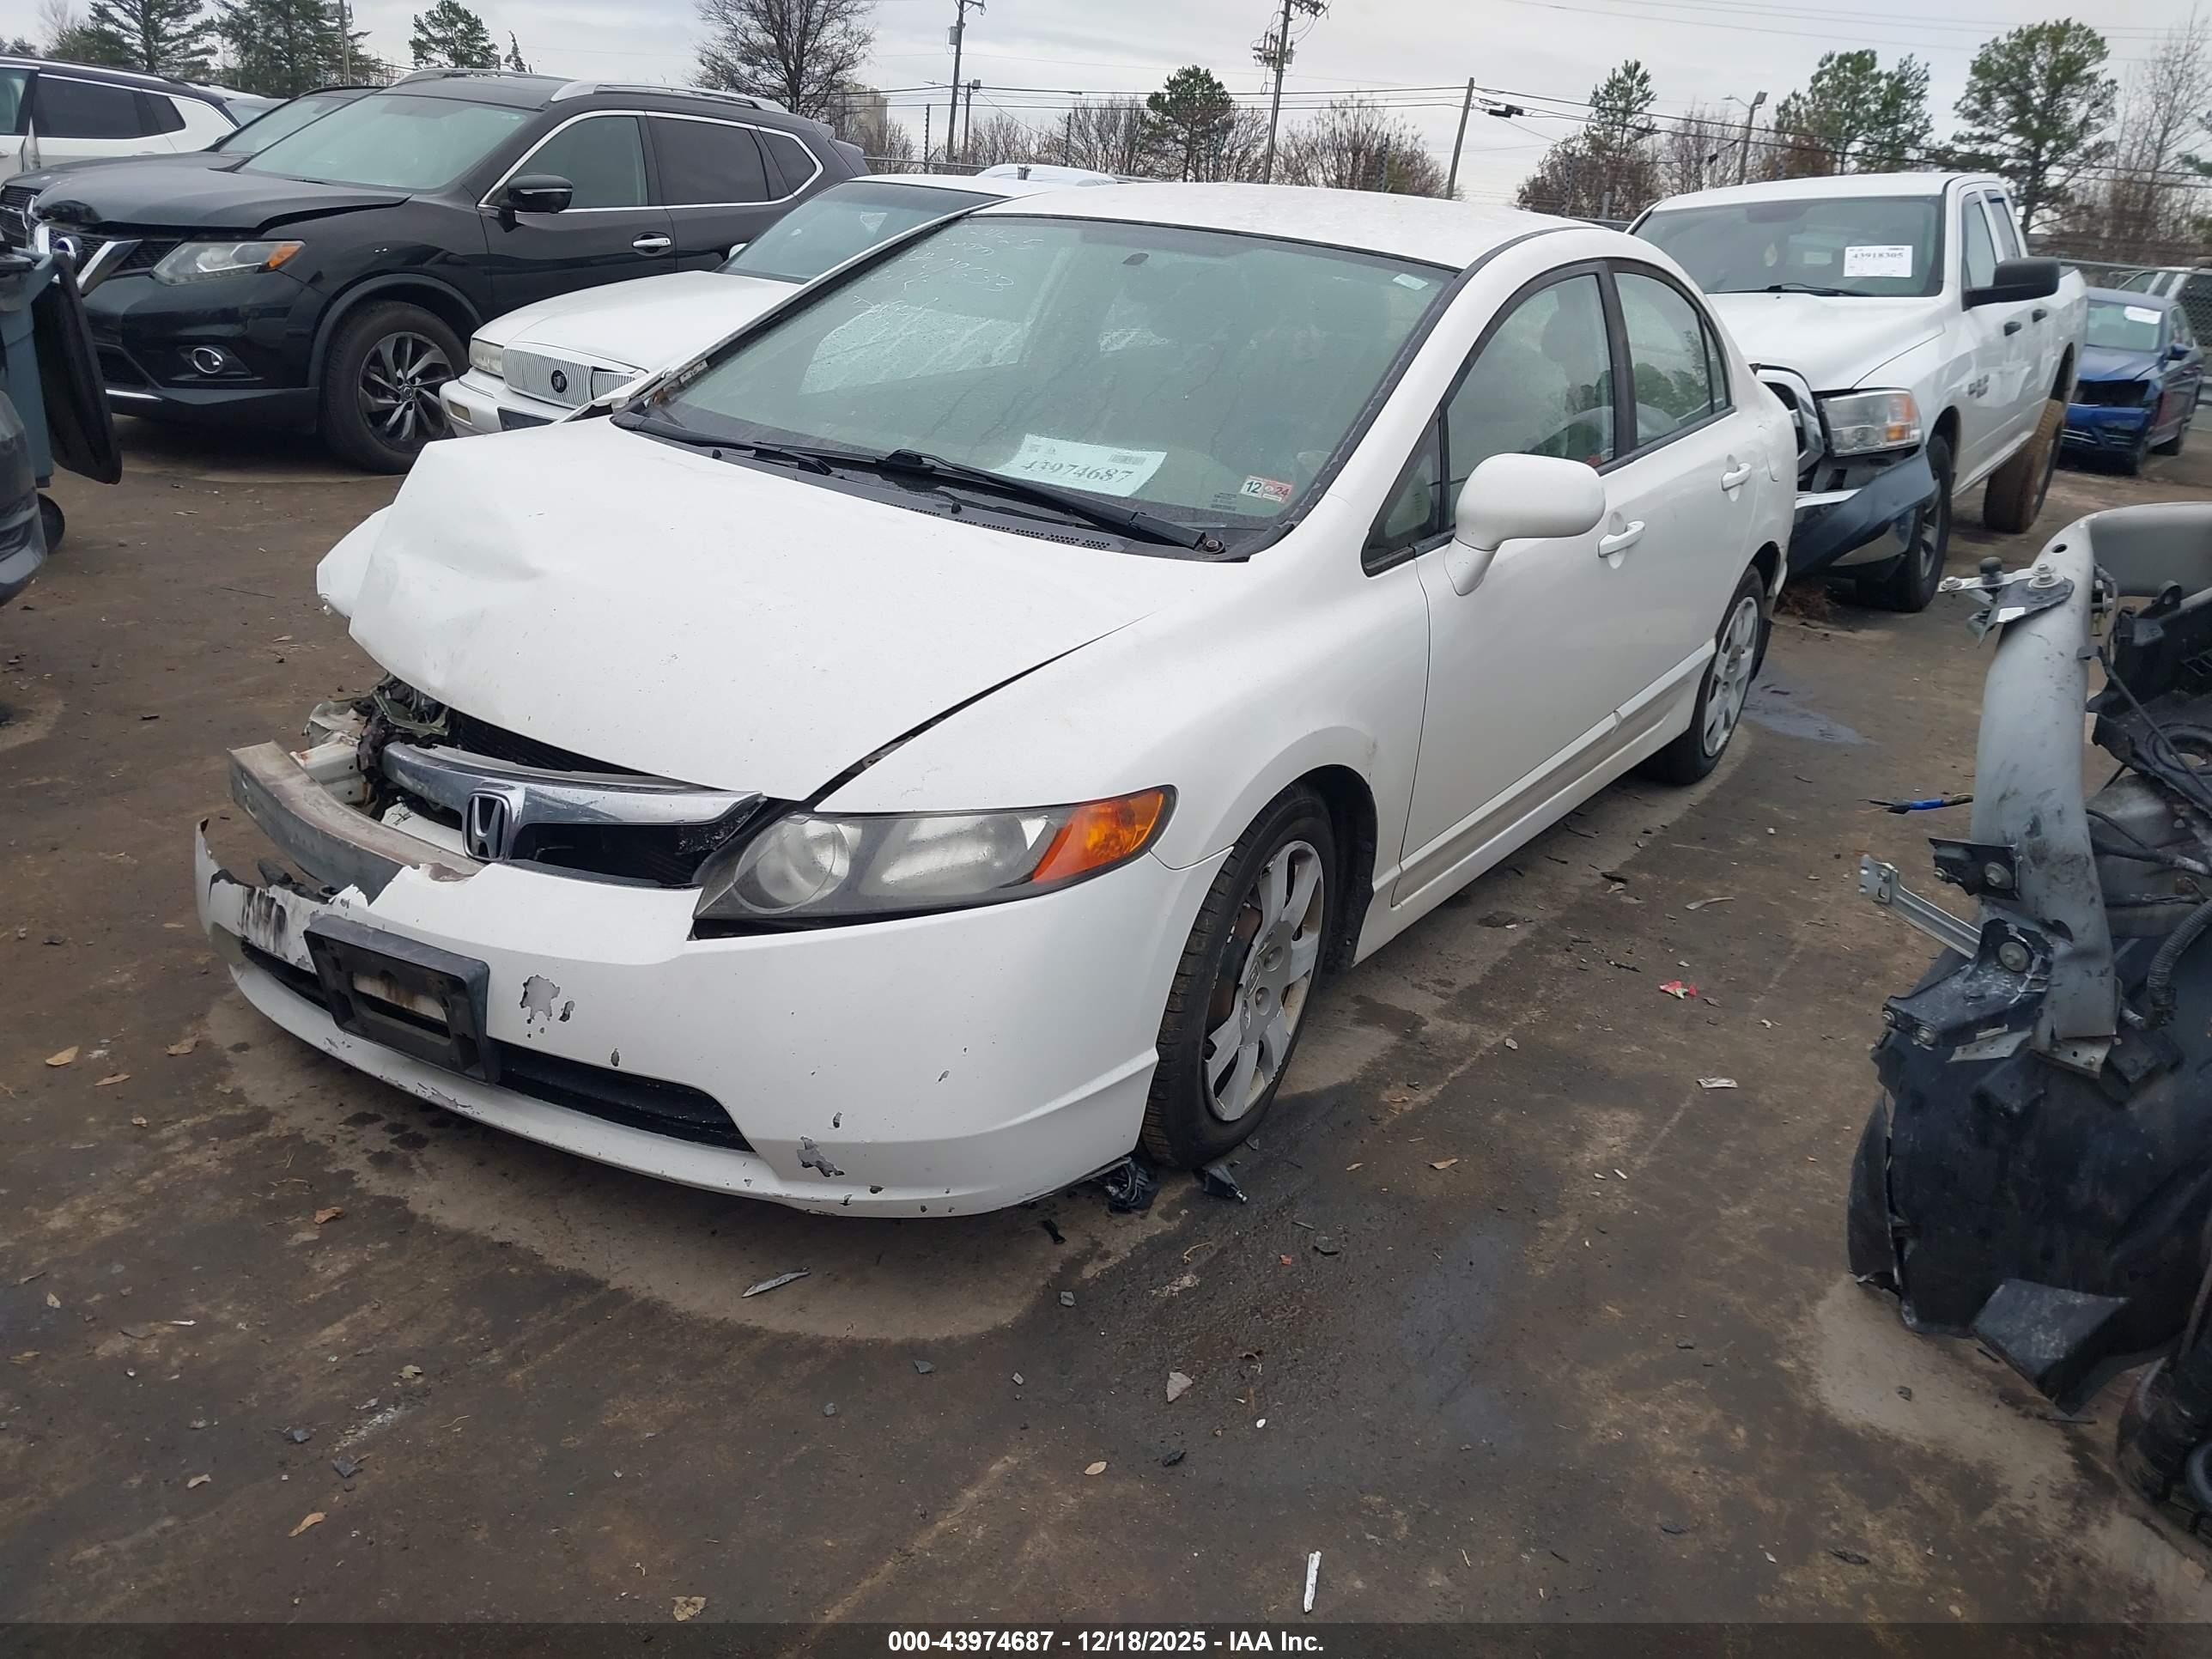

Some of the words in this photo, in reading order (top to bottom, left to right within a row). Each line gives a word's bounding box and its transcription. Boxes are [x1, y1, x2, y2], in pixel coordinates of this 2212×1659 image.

[1021, 460, 1134, 482] 43974687
[1246, 481, 1262, 494] 12
[1276, 486, 1290, 495] 24
